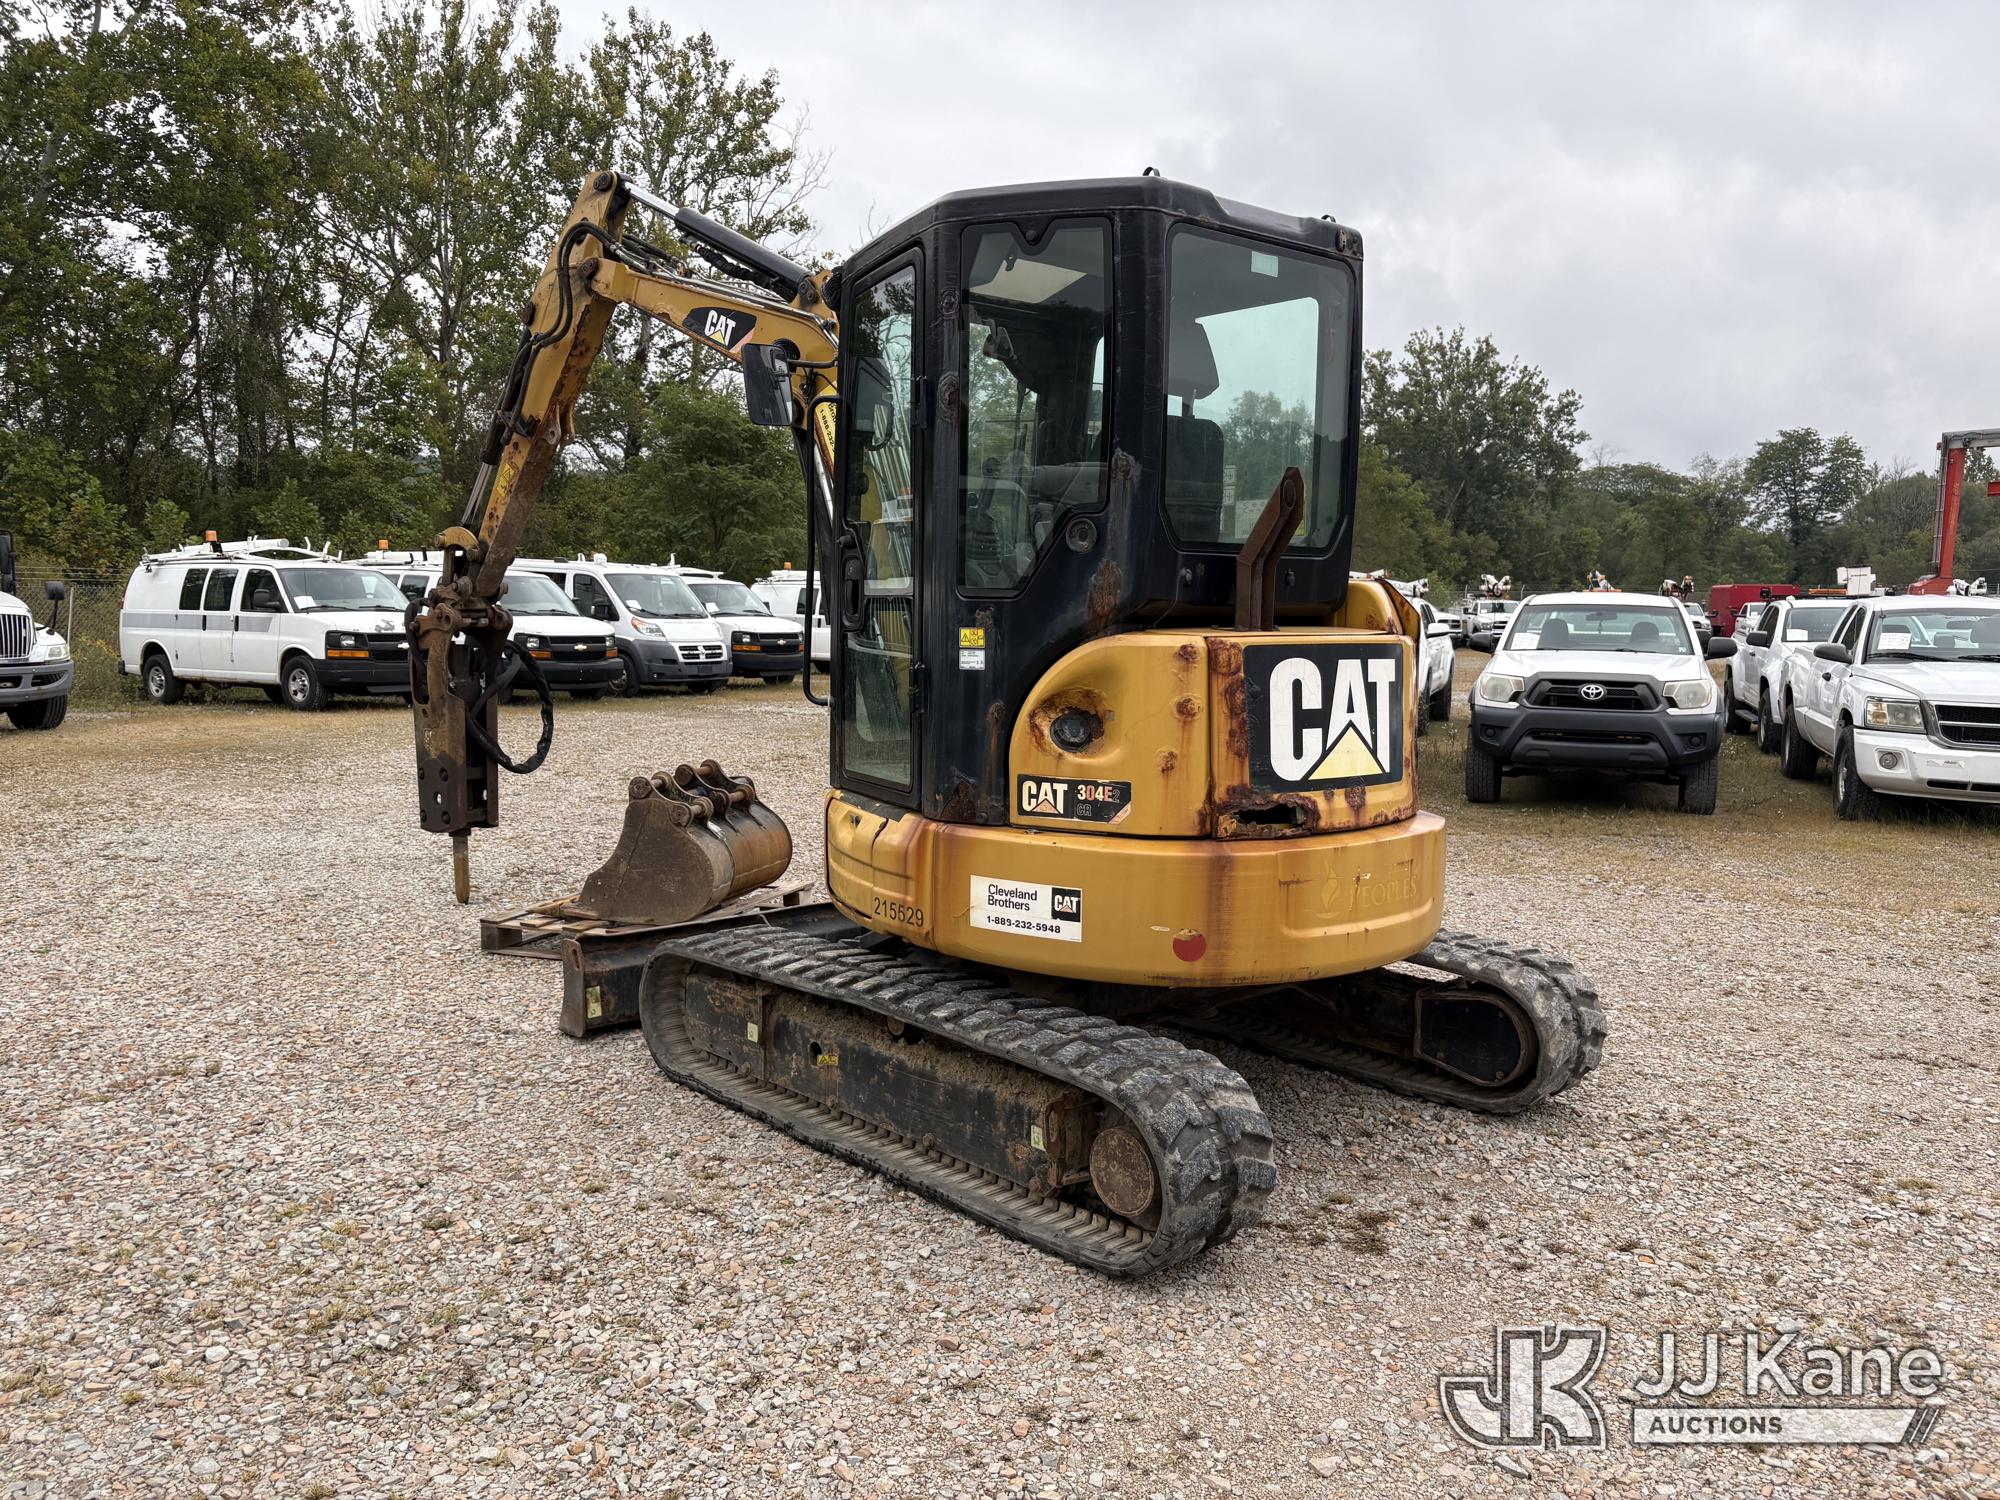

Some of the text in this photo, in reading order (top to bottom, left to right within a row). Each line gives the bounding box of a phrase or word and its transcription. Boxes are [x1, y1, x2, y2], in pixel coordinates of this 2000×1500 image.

[704, 309, 737, 346] CAT
[1269, 656, 1396, 781] CAT
[1022, 780, 1068, 815] CAT
[987, 894, 1031, 911] Brothers
[988, 883, 1038, 901] Cleveland
[1054, 894, 1079, 914] CAT
